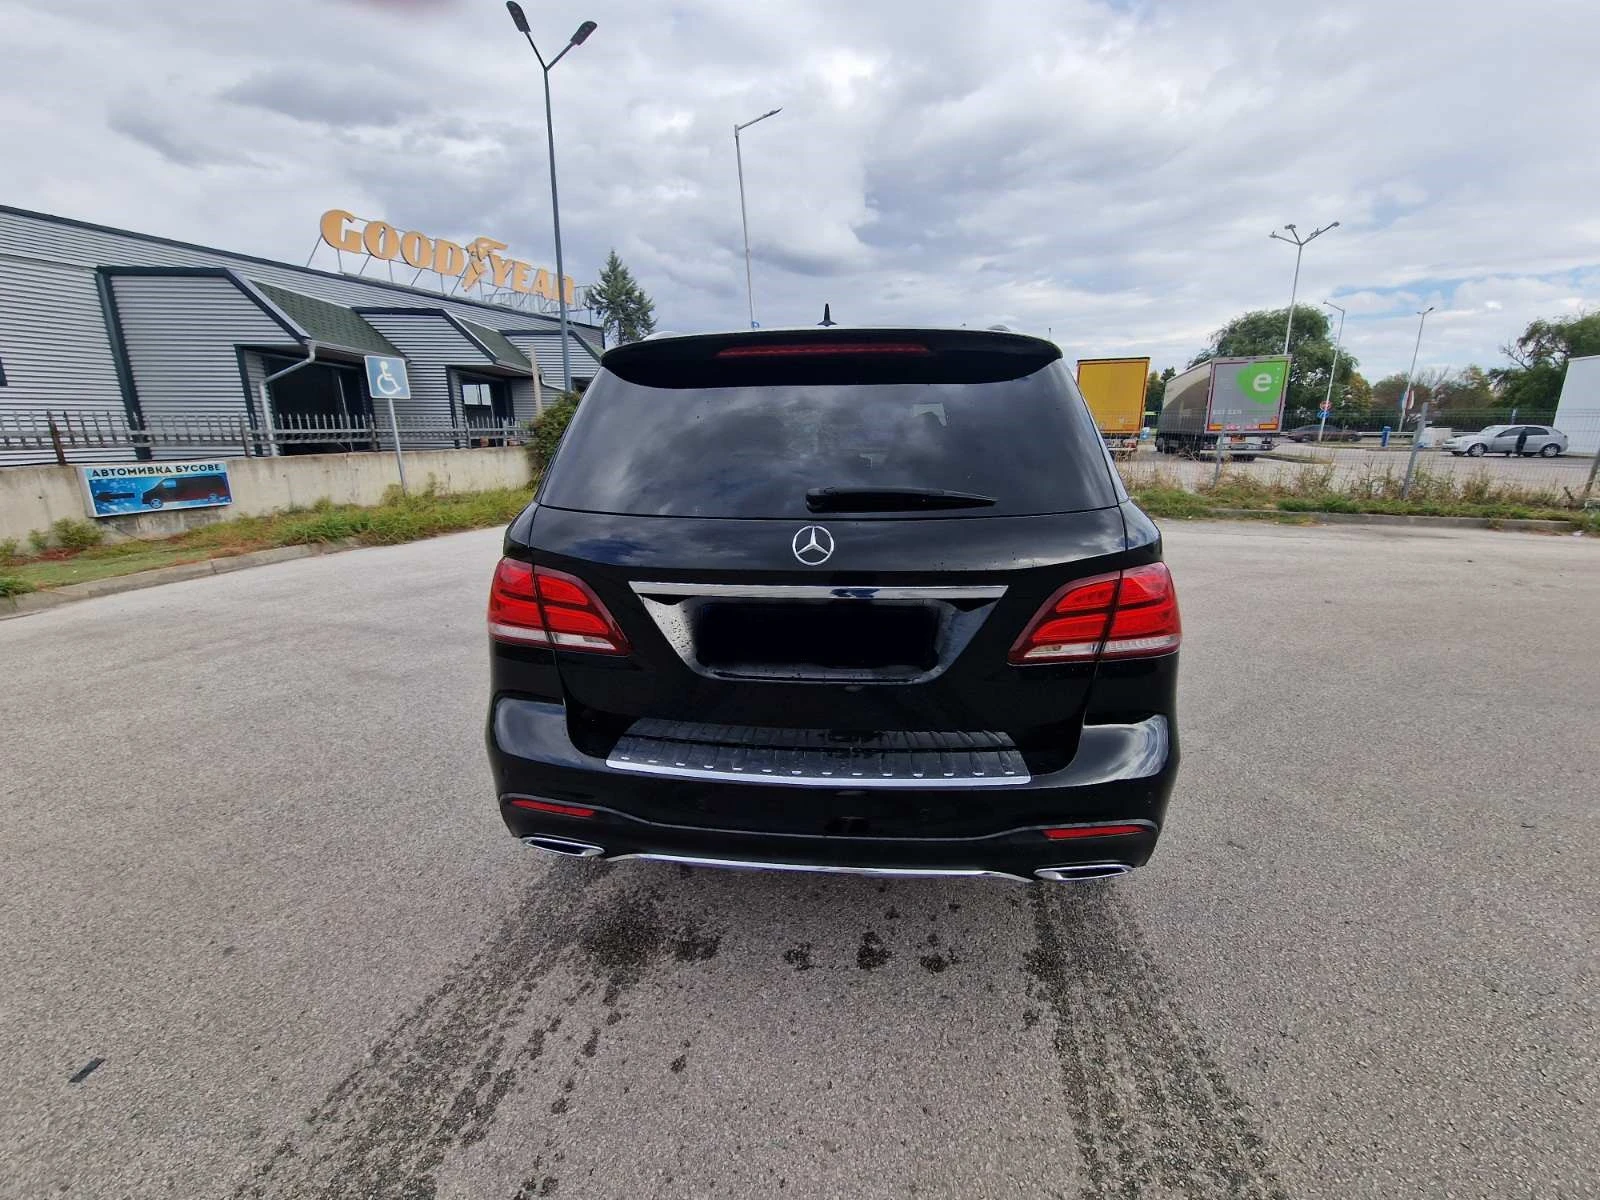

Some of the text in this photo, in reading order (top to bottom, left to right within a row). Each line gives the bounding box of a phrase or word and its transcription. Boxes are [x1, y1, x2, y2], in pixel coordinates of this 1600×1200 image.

[1253, 373, 1272, 392] e
[92, 463, 222, 477] АВТОМИВКА БУСОВЕ
